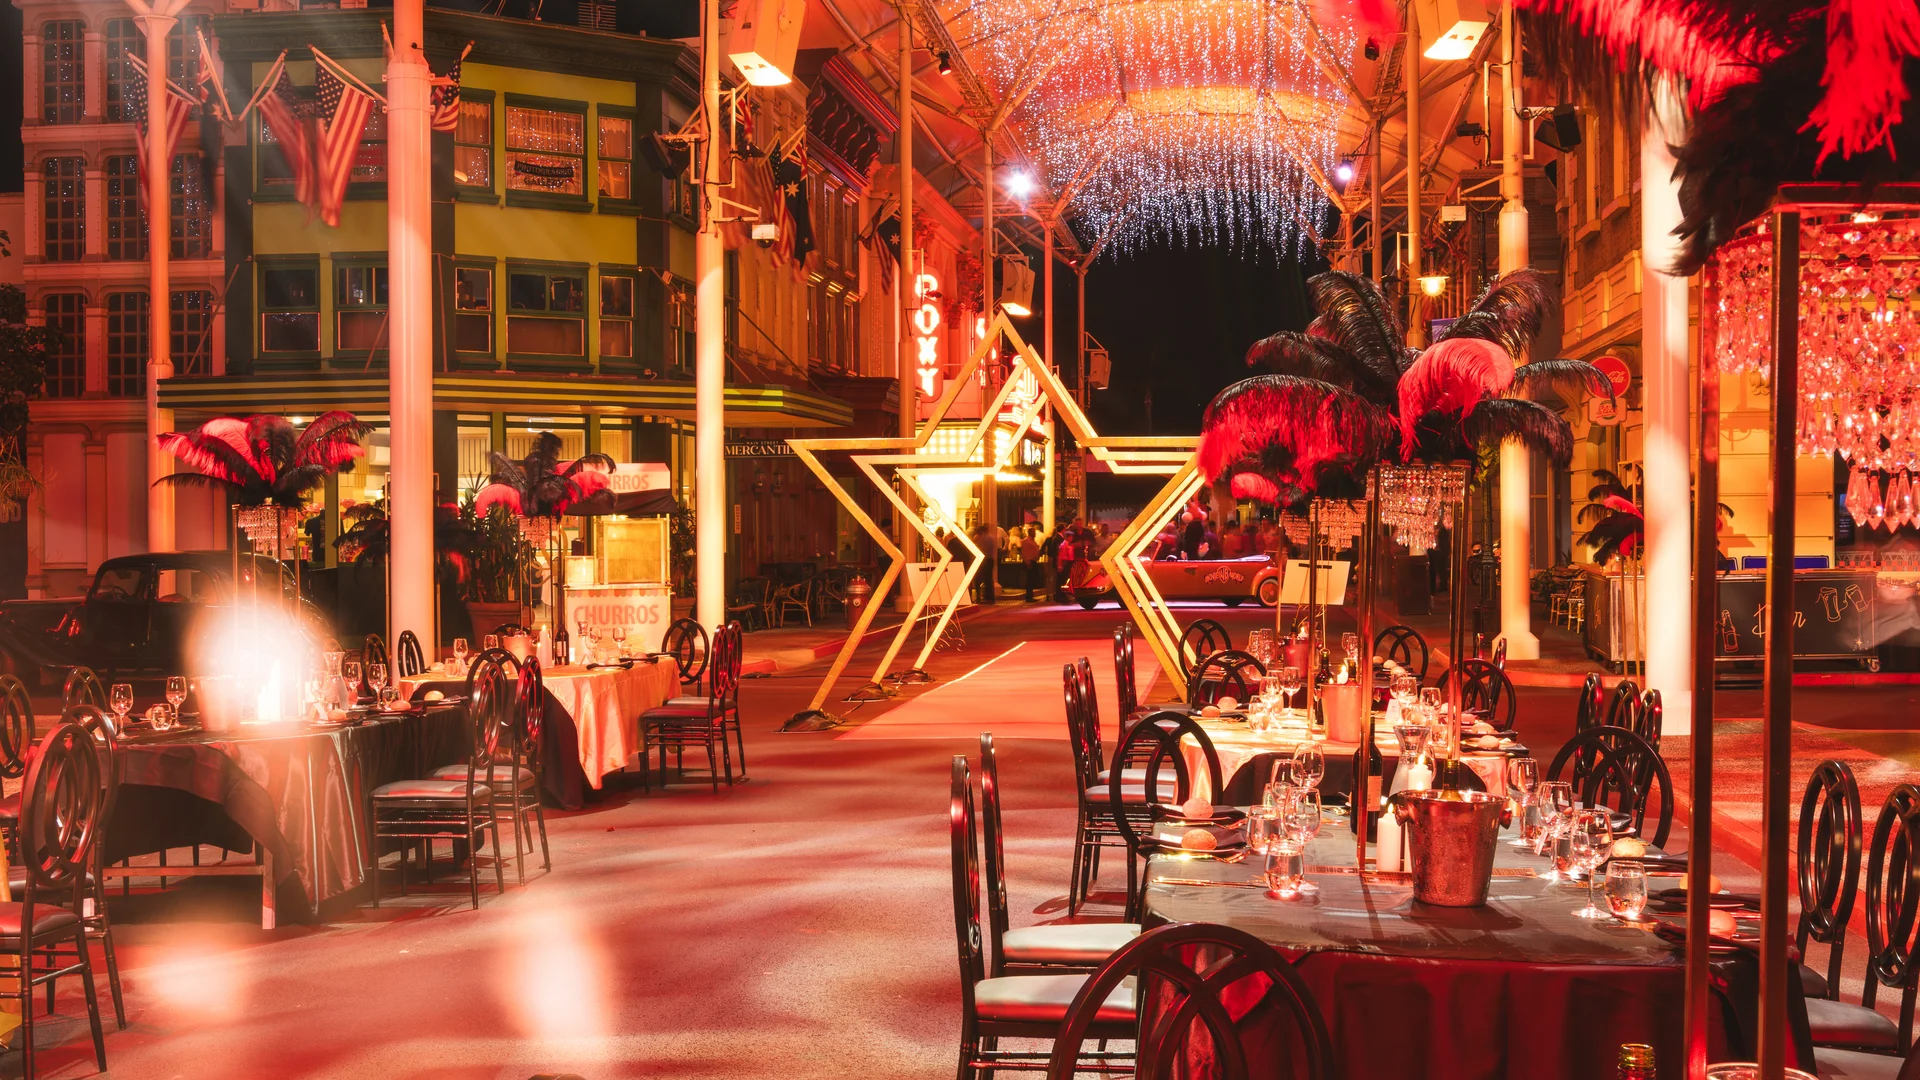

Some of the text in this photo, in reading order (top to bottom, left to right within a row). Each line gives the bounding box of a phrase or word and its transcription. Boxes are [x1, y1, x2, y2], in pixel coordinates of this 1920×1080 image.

[915, 274, 939, 397] ROXY
[724, 445, 797, 456] MERCANTIL
[573, 604, 660, 625] CHURROS
